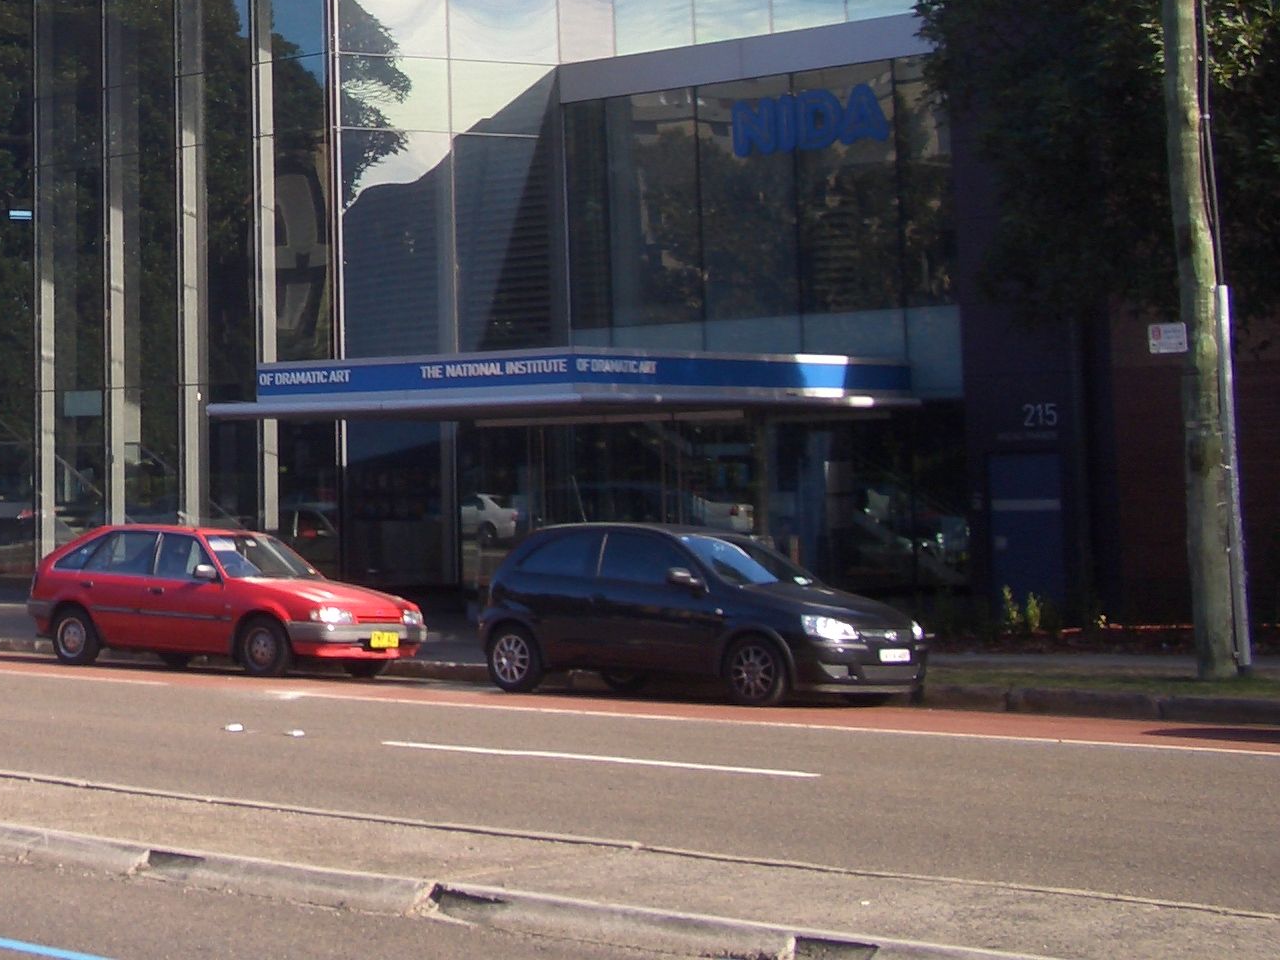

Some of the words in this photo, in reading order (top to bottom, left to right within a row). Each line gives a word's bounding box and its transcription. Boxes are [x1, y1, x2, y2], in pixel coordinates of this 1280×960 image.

[731, 83, 890, 157] NIDA
[259, 373, 274, 386] OF
[275, 370, 328, 386] DRAMATIC
[329, 369, 351, 383] ART
[420, 365, 443, 379] THE
[446, 362, 503, 378] NATIONAL
[505, 359, 568, 375] INSTITUTE
[576, 358, 590, 372] OF
[1022, 403, 1057, 427] 215
